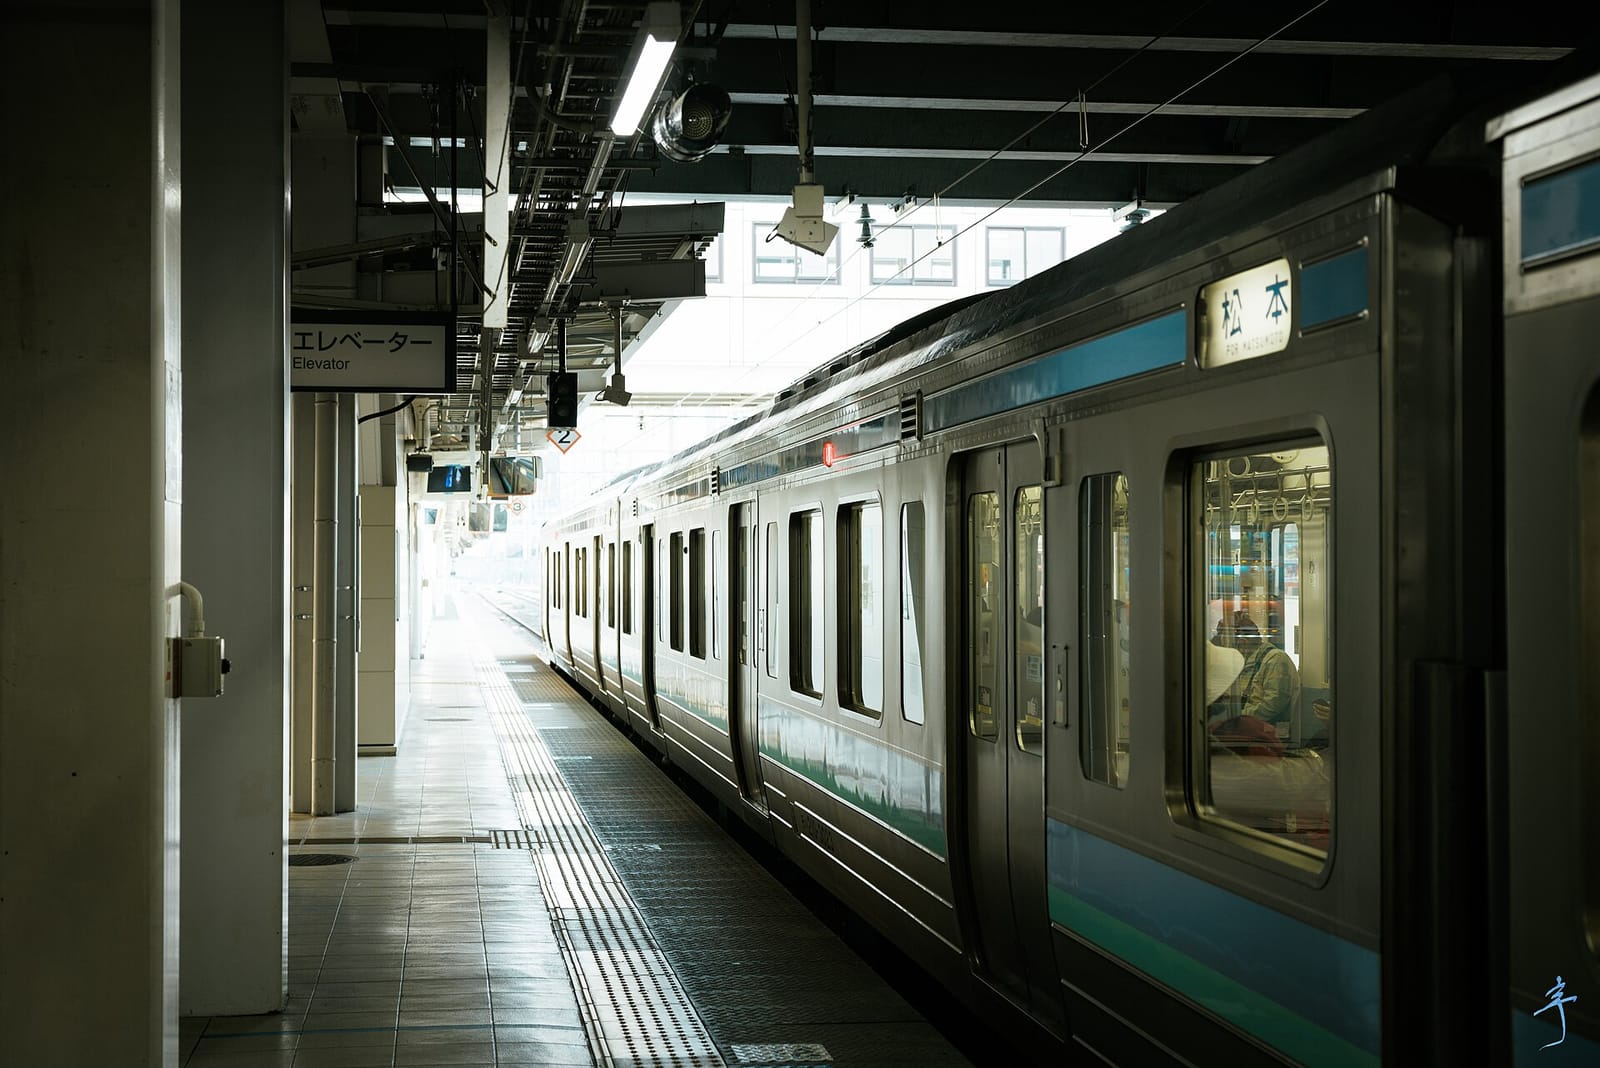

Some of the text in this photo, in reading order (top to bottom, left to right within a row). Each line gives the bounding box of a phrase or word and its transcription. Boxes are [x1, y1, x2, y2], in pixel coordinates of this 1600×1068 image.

[1222, 274, 1288, 340] 松本
[293, 330, 433, 353] エレベーター
[292, 356, 350, 370] Elevator
[557, 430, 571, 443] 2
